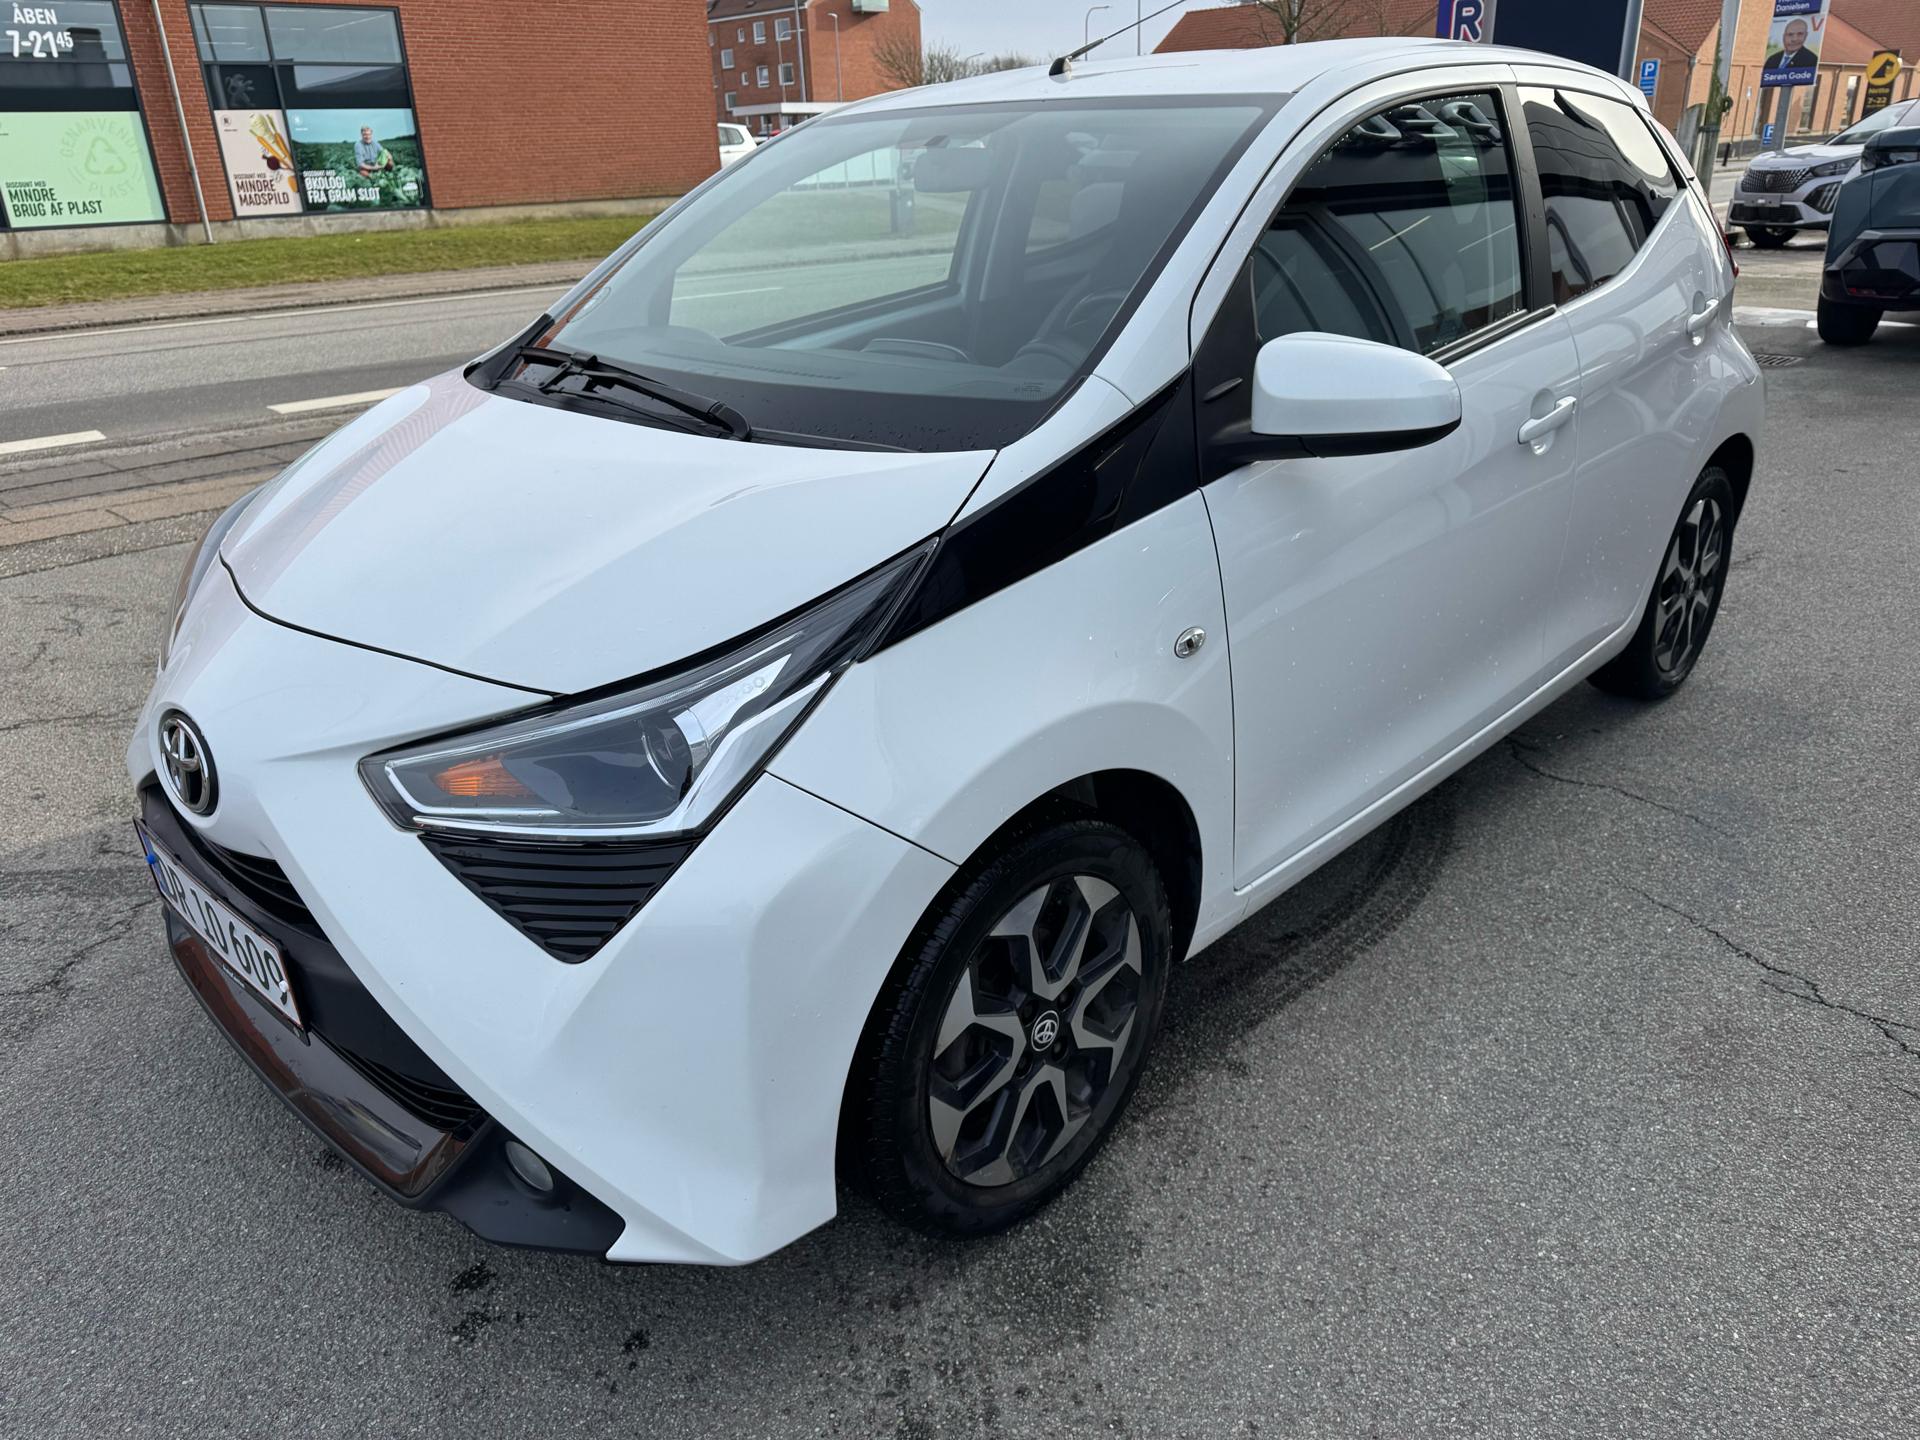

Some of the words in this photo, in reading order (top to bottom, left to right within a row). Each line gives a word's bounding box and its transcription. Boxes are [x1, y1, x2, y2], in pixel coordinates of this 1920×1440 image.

[12, 2, 58, 25] ÅBEN
[1776, 2, 1810, 12] Danielsen
[1452, 0, 1484, 42] R
[1811, 16, 1825, 31] V
[1644, 62, 1655, 76] P
[1764, 73, 1787, 81] Søren
[1788, 71, 1812, 79] Gade
[235, 179, 276, 193] MINDRE
[304, 176, 346, 190] ØKOLOGI
[8, 187, 57, 203] MINDRE
[238, 191, 290, 206] MADSPILD
[307, 190, 328, 204] FRA
[328, 187, 357, 203] GRAM
[357, 187, 380, 201] SLOT
[12, 202, 46, 218] BRUG
[50, 202, 63, 216] AF
[67, 200, 103, 215] PLAST
[190, 886, 229, 955] 10
[229, 920, 288, 1006] 609
